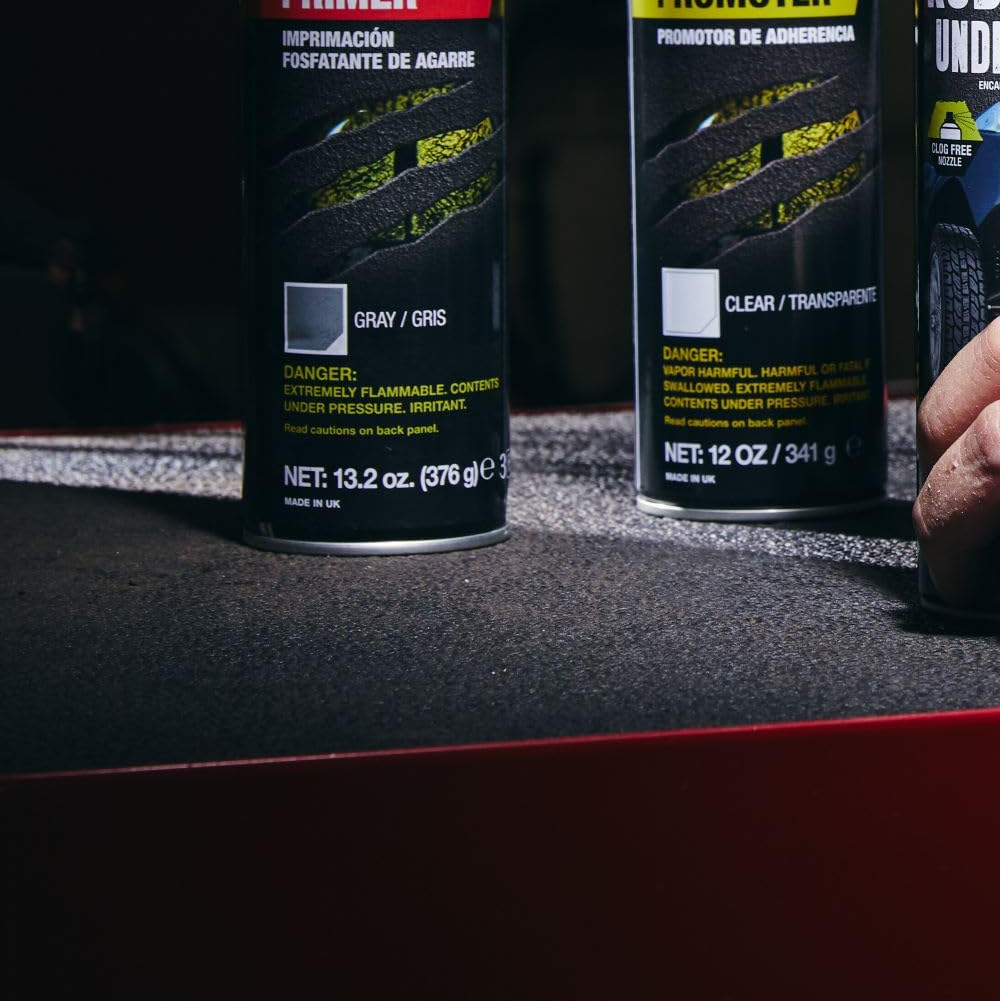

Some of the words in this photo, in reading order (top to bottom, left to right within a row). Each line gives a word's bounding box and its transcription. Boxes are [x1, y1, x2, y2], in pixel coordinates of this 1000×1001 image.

[282, 27, 395, 48] IMPRIMACIÓN
[657, 27, 736, 46] PROMOTOR
[739, 28, 762, 45] DE
[765, 24, 856, 45] ADHERENCIA
[281, 51, 382, 70] FOSFATANTE
[388, 51, 411, 69] DE
[415, 50, 476, 69] AGARRE
[931, 142, 949, 155] CLOG
[950, 144, 972, 156] FREE
[938, 156, 962, 167] NOZZLE
[724, 295, 775, 312] CLEAR
[778, 294, 787, 312] /
[788, 286, 877, 311] TRANSPARENTE
[354, 311, 396, 328] GRAY
[400, 310, 408, 328] /
[411, 309, 447, 327] GRIS
[663, 346, 724, 363] DANGER:
[283, 365, 357, 381] DANGER:
[663, 365, 694, 377] VAPOR
[698, 366, 758, 378] HARMFUL.
[760, 364, 818, 377] HARMFUL
[283, 385, 357, 398] EXTREMELY
[360, 384, 447, 398] FLAMMABLE.
[450, 377, 500, 395] CONTENTS
[663, 381, 733, 394] SWALLOWED.
[735, 381, 806, 394] EXTREMELY
[284, 401, 325, 414] UNDER
[328, 402, 406, 415] PRESSURE.
[410, 399, 467, 413] IRRITANT.
[663, 396, 718, 410] CONTENTS
[720, 398, 763, 410] UNDER
[663, 415, 686, 426] Read
[688, 418, 729, 428] cautions
[732, 419, 746, 428] on
[748, 418, 774, 428] back
[284, 424, 308, 434] Read
[310, 425, 356, 436] cautions
[359, 428, 373, 436] on
[376, 426, 404, 435] back
[407, 424, 439, 437] panel.
[664, 441, 704, 465] NET:
[708, 444, 732, 465] 12
[734, 444, 769, 466] OZ
[771, 443, 782, 466] /
[784, 443, 819, 464] 341
[823, 444, 837, 466] g
[284, 465, 328, 488] NET:
[333, 467, 378, 489] 13.2
[382, 471, 415, 488] oz.
[420, 465, 460, 492] (376
[463, 461, 479, 488] g)
[665, 473, 689, 482] MADE
[691, 474, 701, 483] IN
[702, 474, 717, 484] UK
[284, 497, 310, 507] MADE
[313, 497, 323, 507] IN
[326, 498, 341, 509] UK
